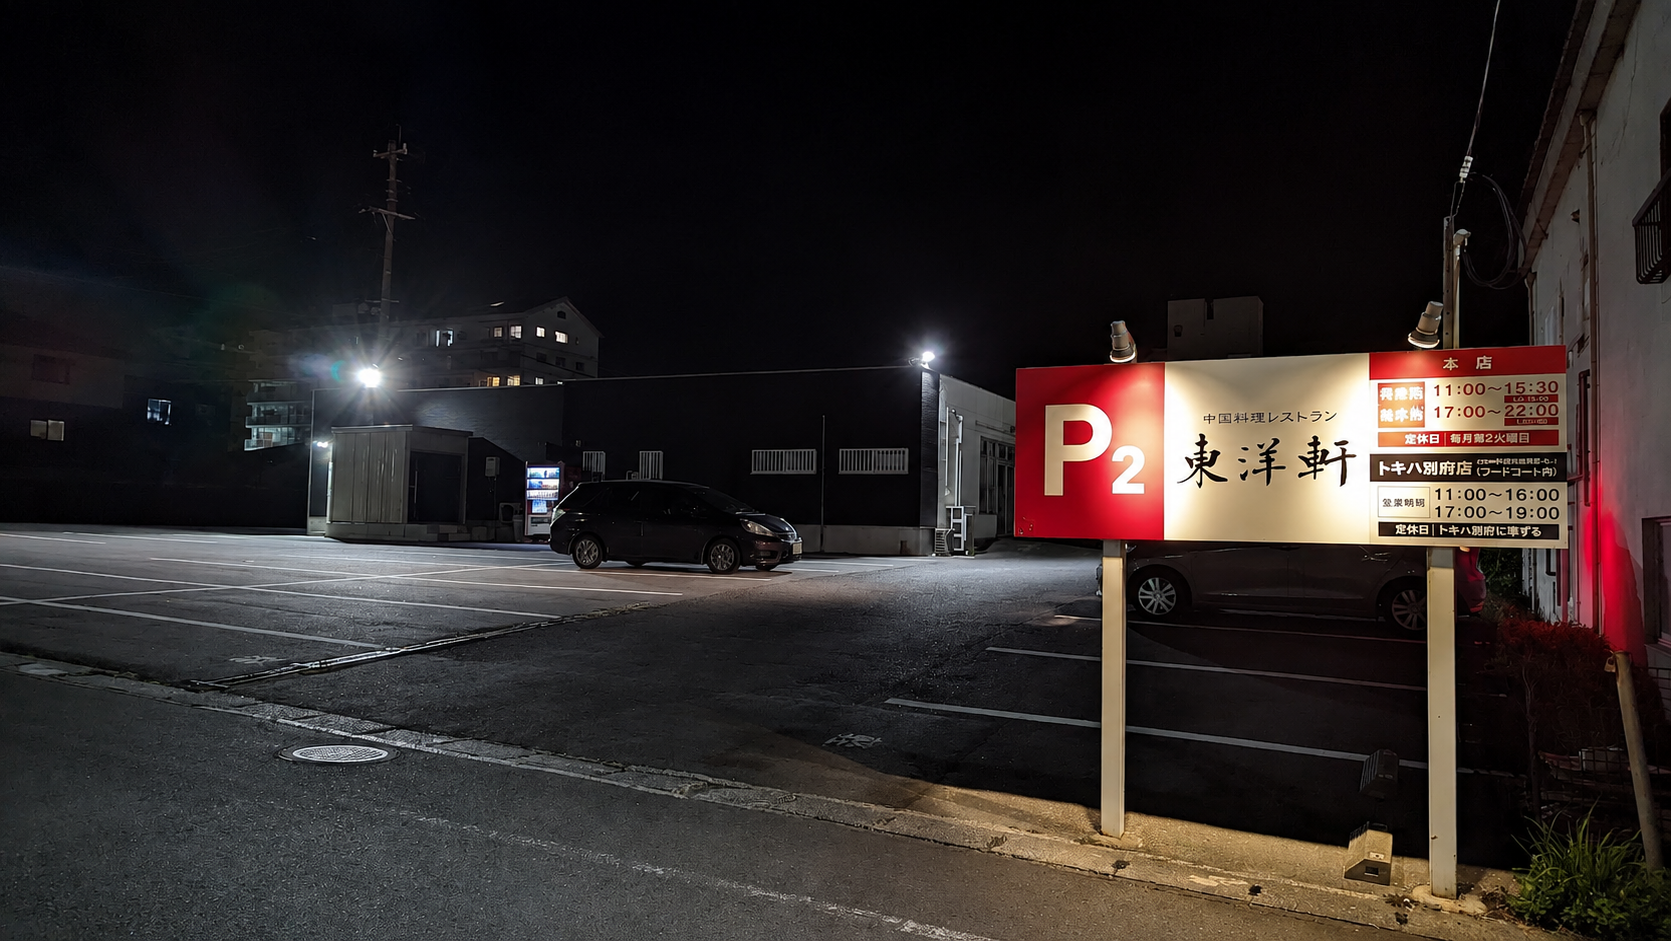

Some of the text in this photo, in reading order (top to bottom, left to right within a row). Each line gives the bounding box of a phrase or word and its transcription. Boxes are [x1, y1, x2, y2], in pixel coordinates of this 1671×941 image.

[1443, 356, 1492, 371] 本店
[1203, 410, 1338, 425] 中国料理レストラン
[1405, 433, 1440, 445] 定休日
[1044, 403, 1146, 496] P2
[1177, 433, 1357, 489] 東洋軒
[1379, 460, 1473, 476] トキハ別府店
[1395, 523, 1429, 536] 定休日
